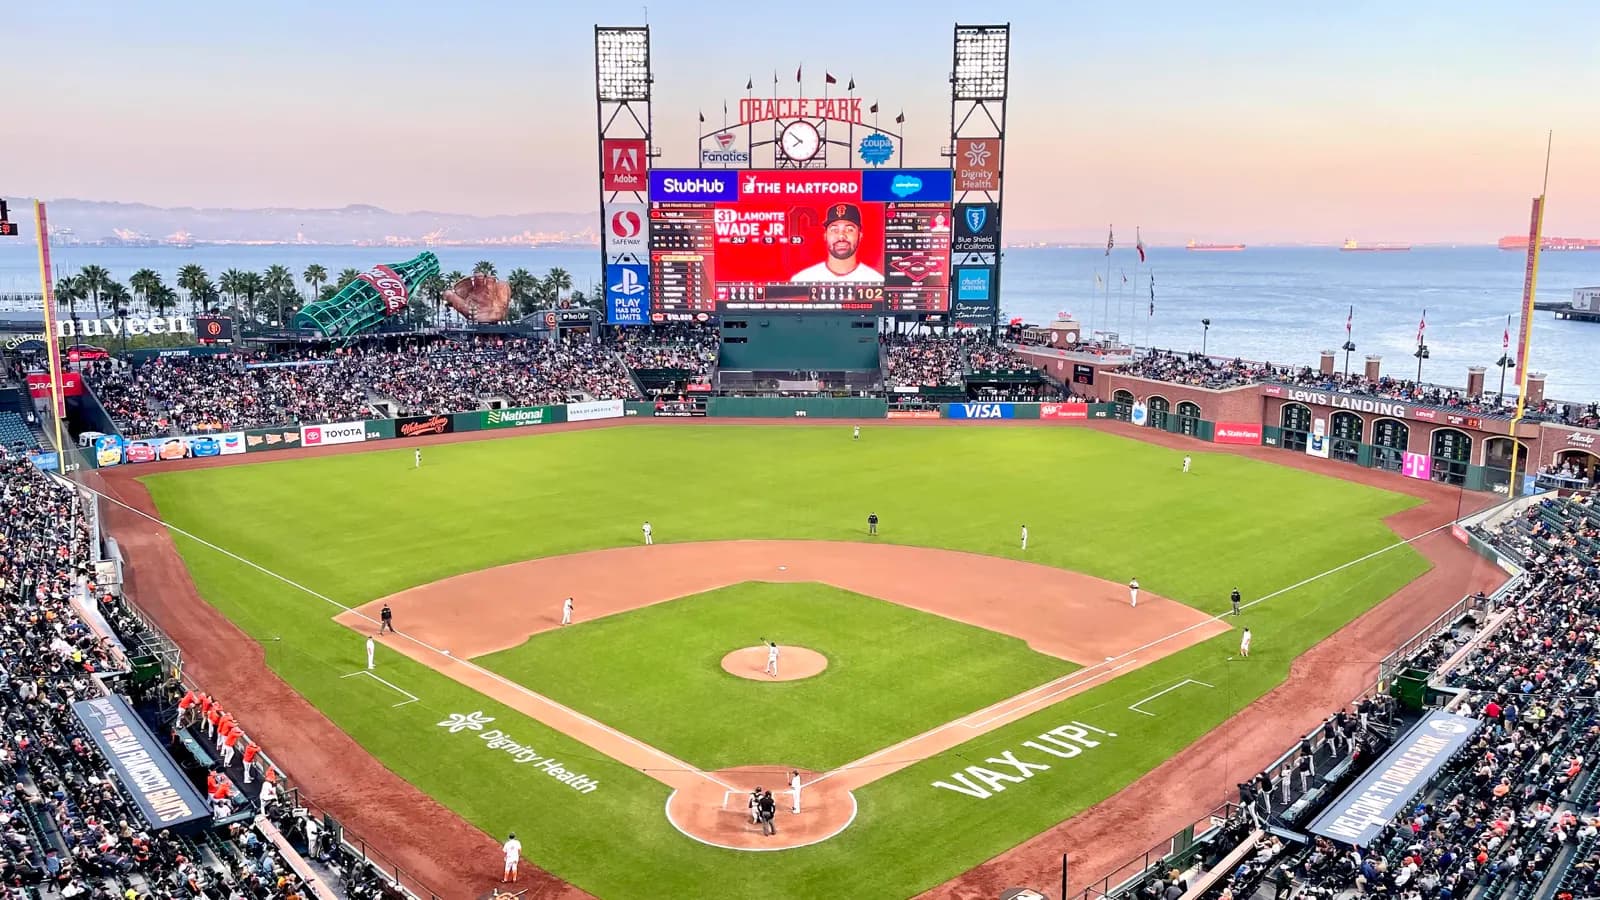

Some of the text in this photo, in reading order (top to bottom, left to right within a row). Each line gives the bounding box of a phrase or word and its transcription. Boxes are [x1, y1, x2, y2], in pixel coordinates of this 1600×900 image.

[740, 98, 862, 124] ORACLE PARK
[864, 139, 891, 148] coupa
[703, 151, 748, 162] Fanatics
[613, 174, 638, 183] Adobe
[961, 170, 992, 181] Dignity
[664, 178, 725, 192] StubHub
[757, 183, 858, 194] THE HARTFORD
[718, 210, 784, 221] 31 LAMONTE
[716, 223, 784, 235] WADE JR
[615, 298, 640, 307] PLAY
[57, 316, 190, 337] nuveen
[29, 381, 74, 390] ORALE
[962, 405, 1002, 418] VISA
[1332, 395, 1405, 417] LANDING
[501, 409, 543, 420] National
[325, 428, 362, 438] TOYOTA
[107, 735, 144, 754] SAN
[1408, 734, 1450, 756] PARK
[479, 729, 599, 794] Dignity Health
[930, 720, 1118, 799] VAX UP!
[118, 748, 172, 793] FRANCISCO
[1381, 752, 1433, 784] ORACLE
[1368, 780, 1405, 796] TO
[145, 788, 192, 822] GIANTS
[1326, 792, 1393, 838] WELCOME
